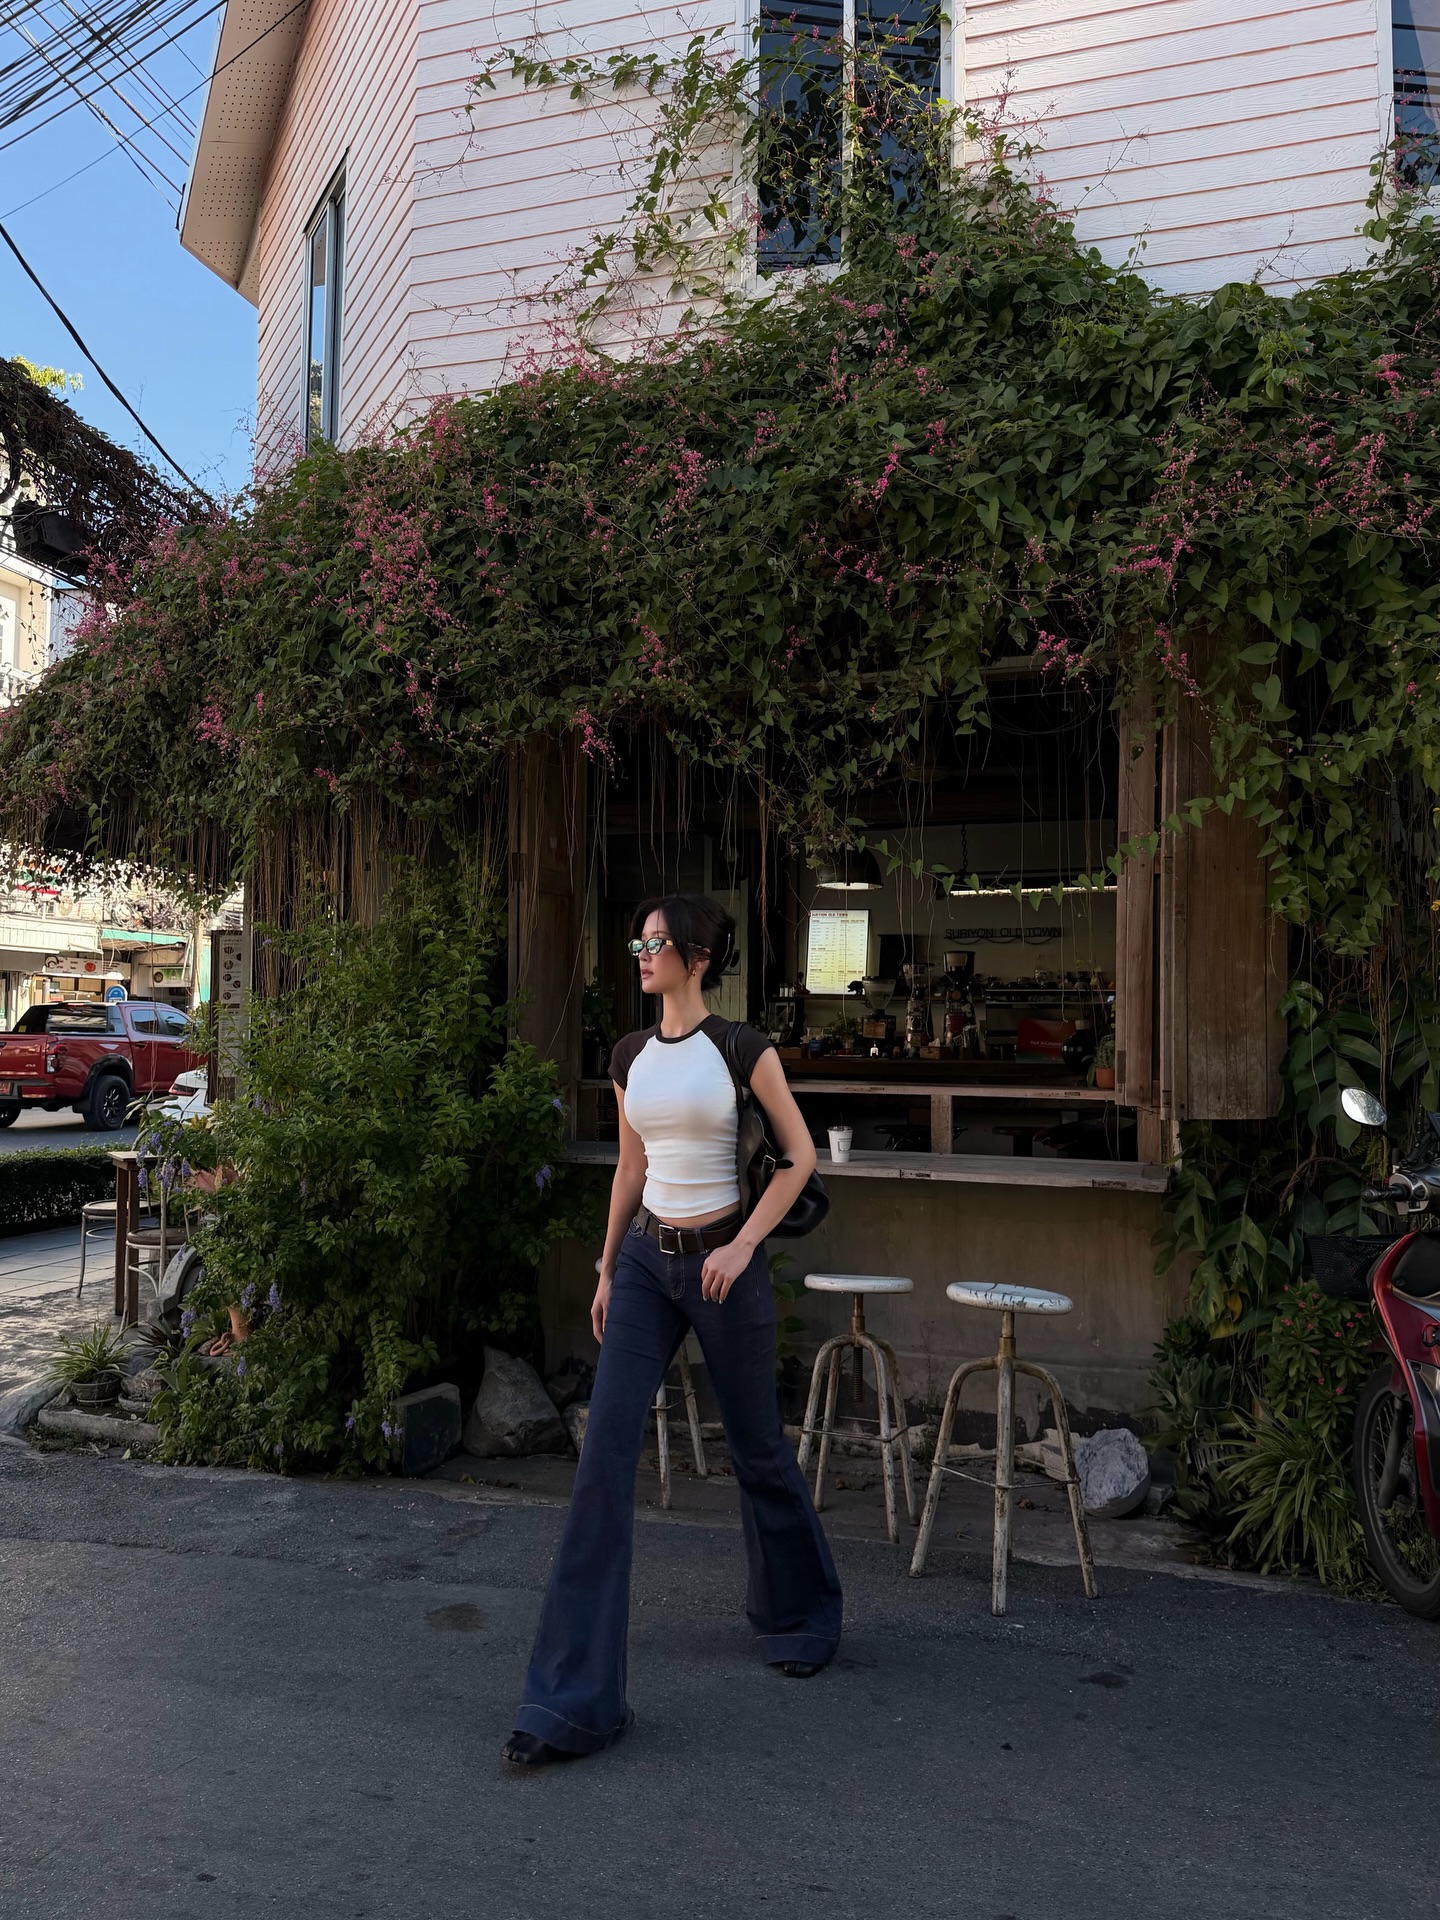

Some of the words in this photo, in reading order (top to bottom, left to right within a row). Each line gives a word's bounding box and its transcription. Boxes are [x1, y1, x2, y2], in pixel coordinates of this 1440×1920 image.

[945, 928, 993, 938] SURIYON
[1000, 928, 1021, 938] OLD
[1025, 927, 1062, 938] TOWN
